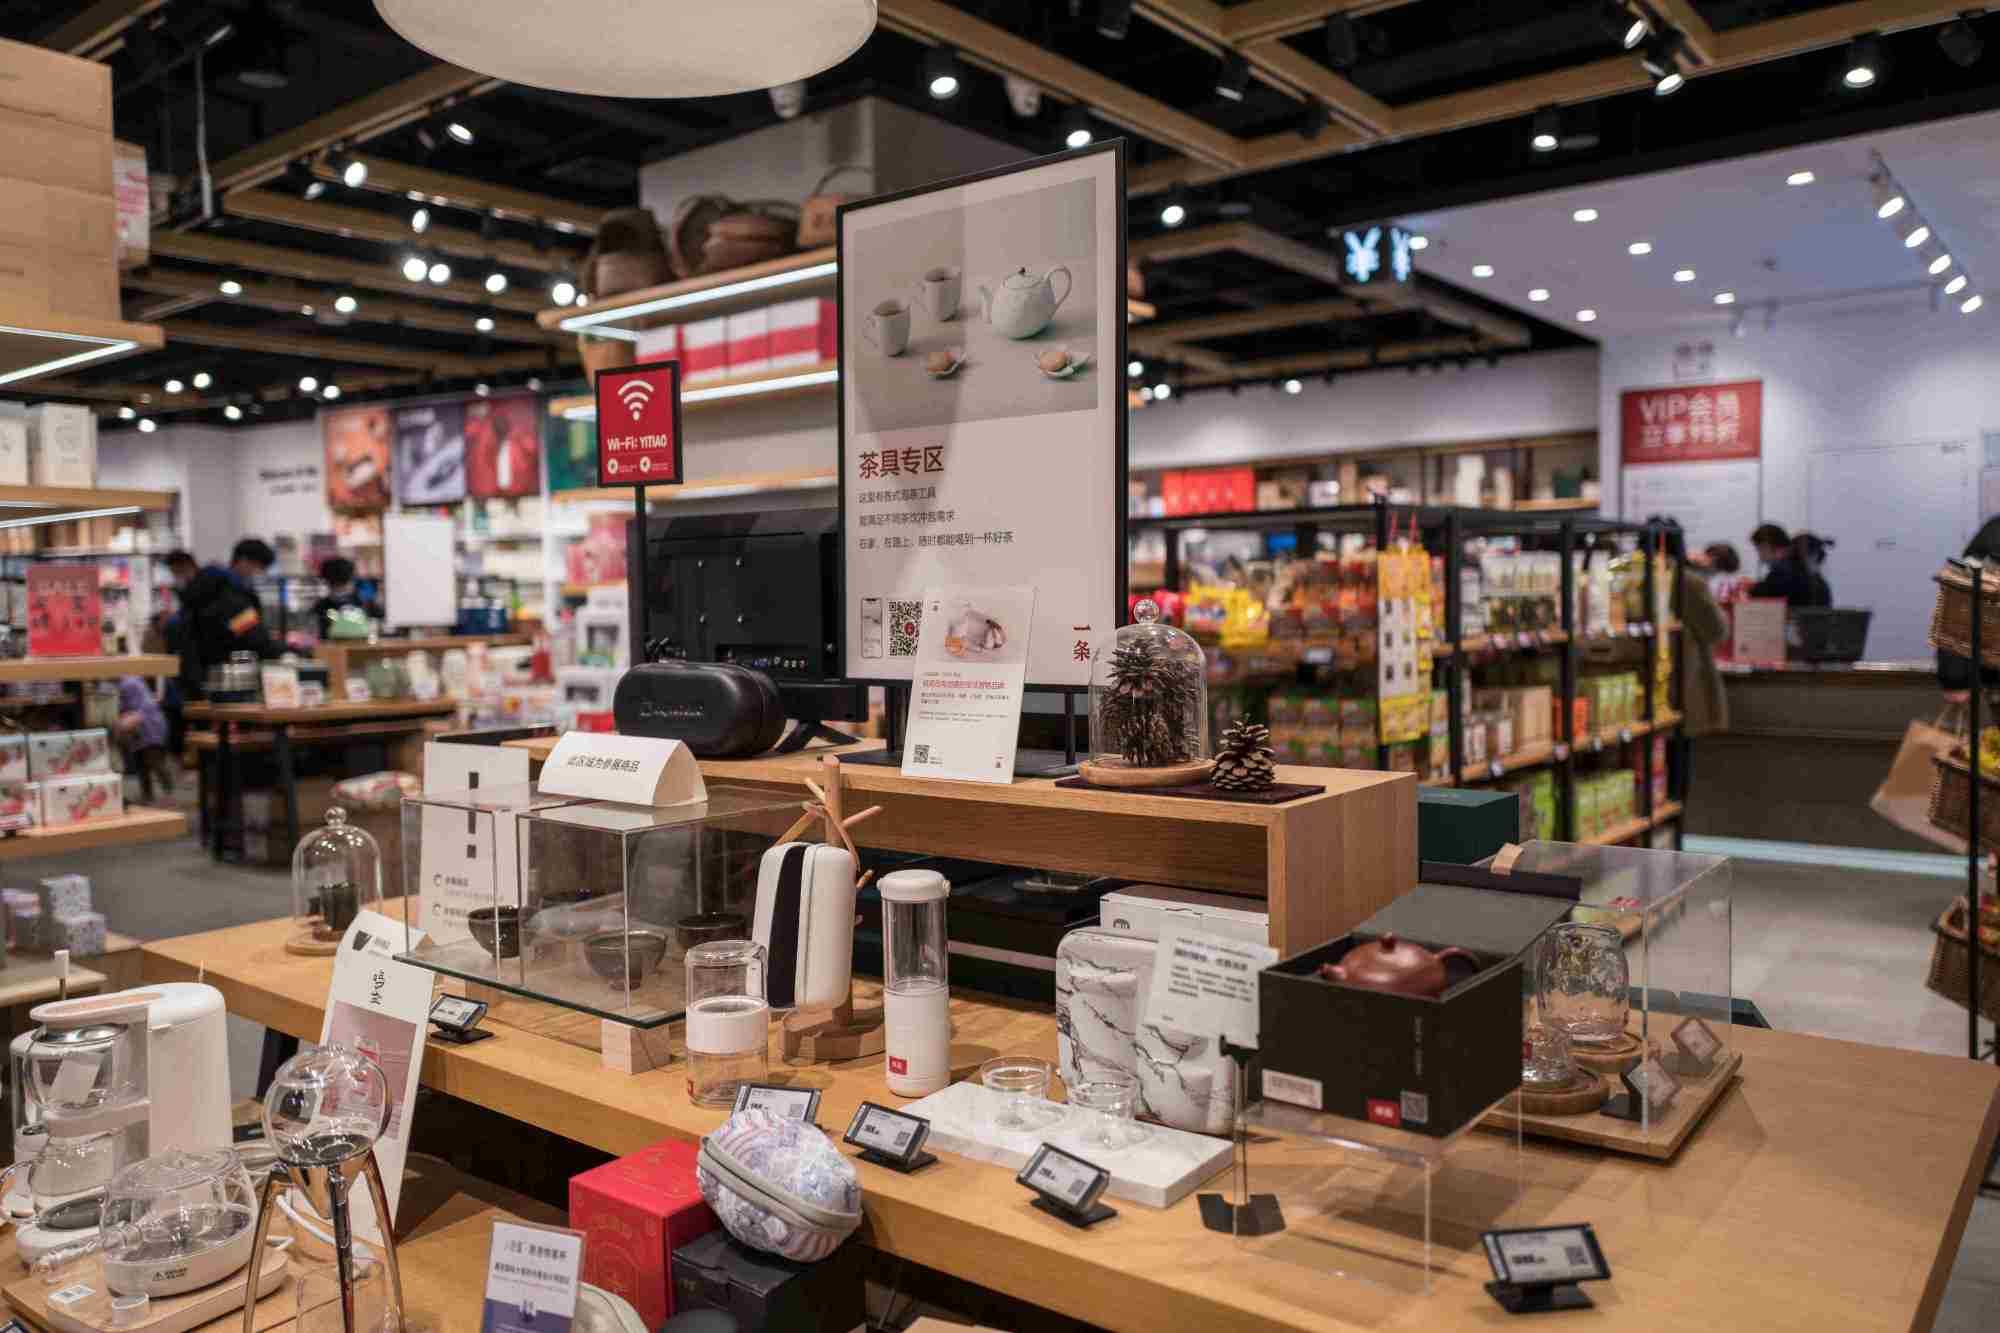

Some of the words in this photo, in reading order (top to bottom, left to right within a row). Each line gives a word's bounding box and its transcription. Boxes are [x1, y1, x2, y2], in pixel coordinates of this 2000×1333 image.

[640, 434, 667, 449] YITIAO
[859, 446, 944, 479] 茶具专区
